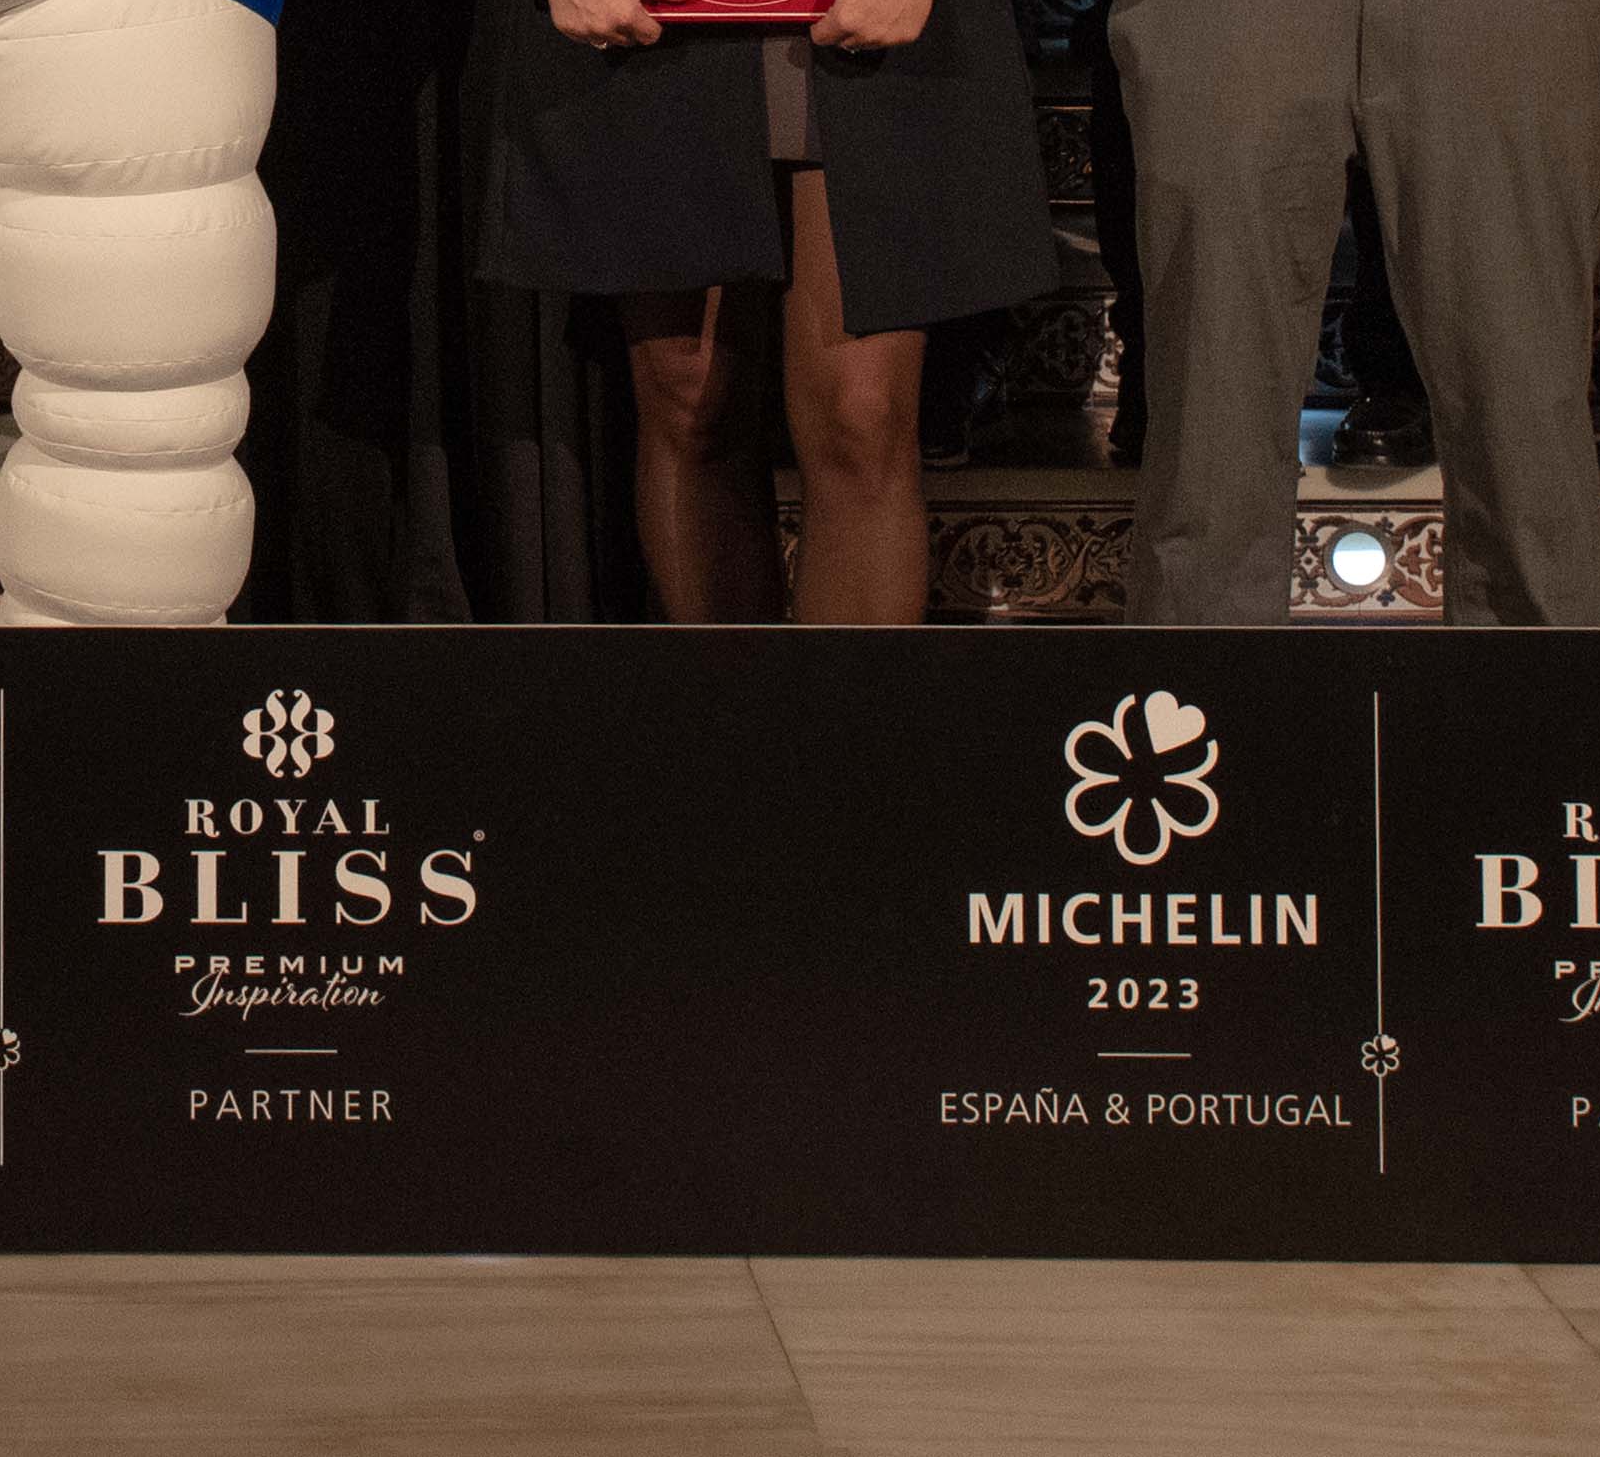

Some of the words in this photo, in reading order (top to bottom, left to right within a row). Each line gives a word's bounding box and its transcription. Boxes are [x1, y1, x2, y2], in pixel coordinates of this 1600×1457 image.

[185, 799, 389, 838] ROYAL
[969, 893, 1317, 944] MICHELIN
[175, 956, 403, 976] PREMIUM
[180, 968, 384, 1021] Inspiration
[1088, 978, 1198, 1009] 2023
[191, 1090, 391, 1120] PARTNER
[941, 1088, 1089, 1124] ESPAÑA
[1105, 1093, 1130, 1124] &
[1148, 1094, 1351, 1126] PORTUGAL
